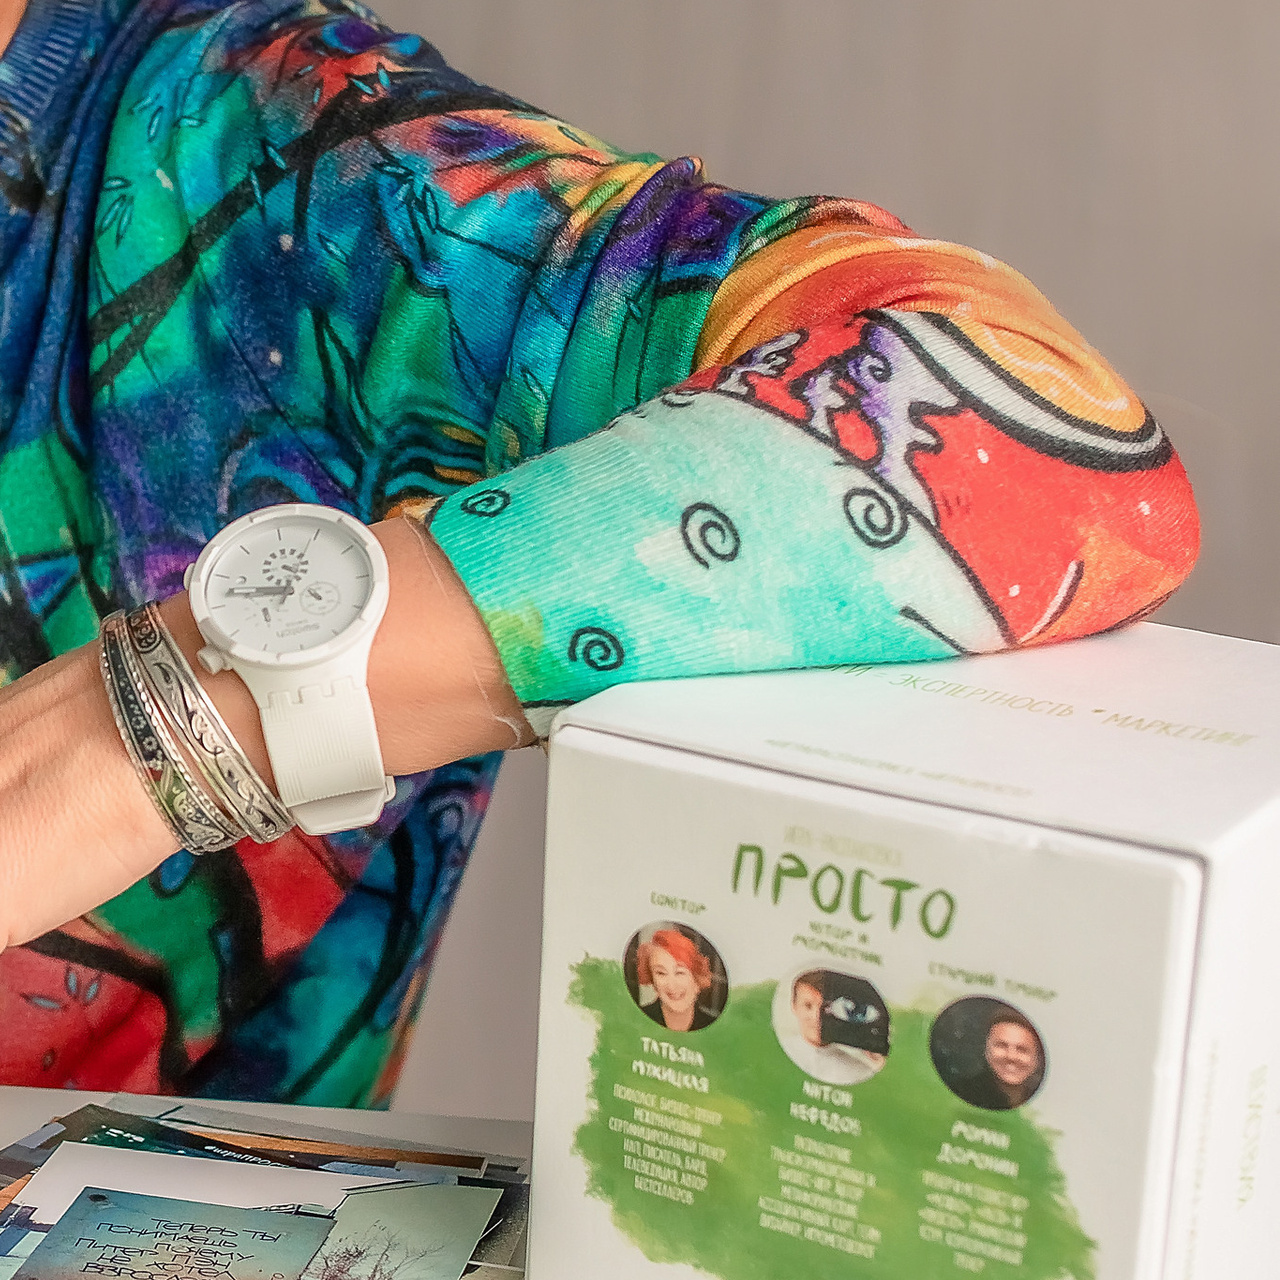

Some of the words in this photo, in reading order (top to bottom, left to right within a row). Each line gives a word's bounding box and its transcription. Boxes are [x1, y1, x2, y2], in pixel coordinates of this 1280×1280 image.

[888, 673, 1074, 718] ЭКСПЕРТНОСТЬ
[731, 843, 957, 940] ПРОСТО
[641, 1036, 705, 1068] ТАТЬЯНА
